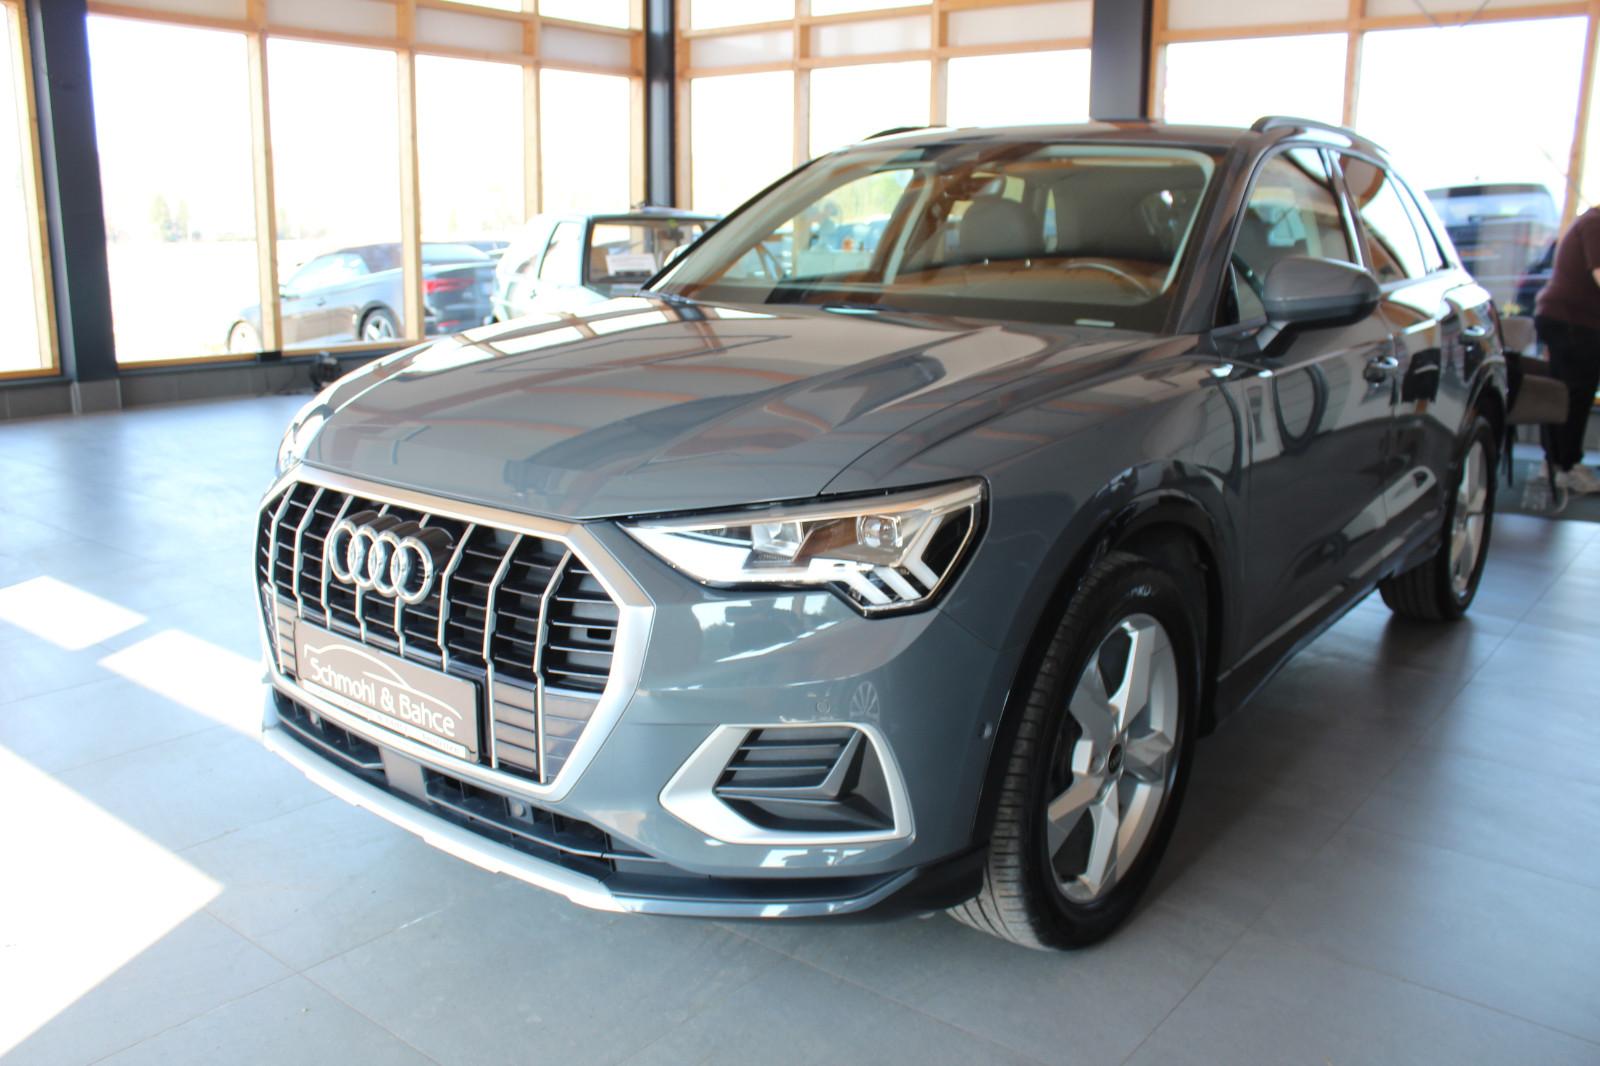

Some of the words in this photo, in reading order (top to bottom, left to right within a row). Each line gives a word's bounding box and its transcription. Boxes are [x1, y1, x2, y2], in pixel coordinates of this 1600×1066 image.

[309, 657, 376, 706] Schmohl
[380, 686, 396, 715] &
[398, 693, 456, 738] Bahce
